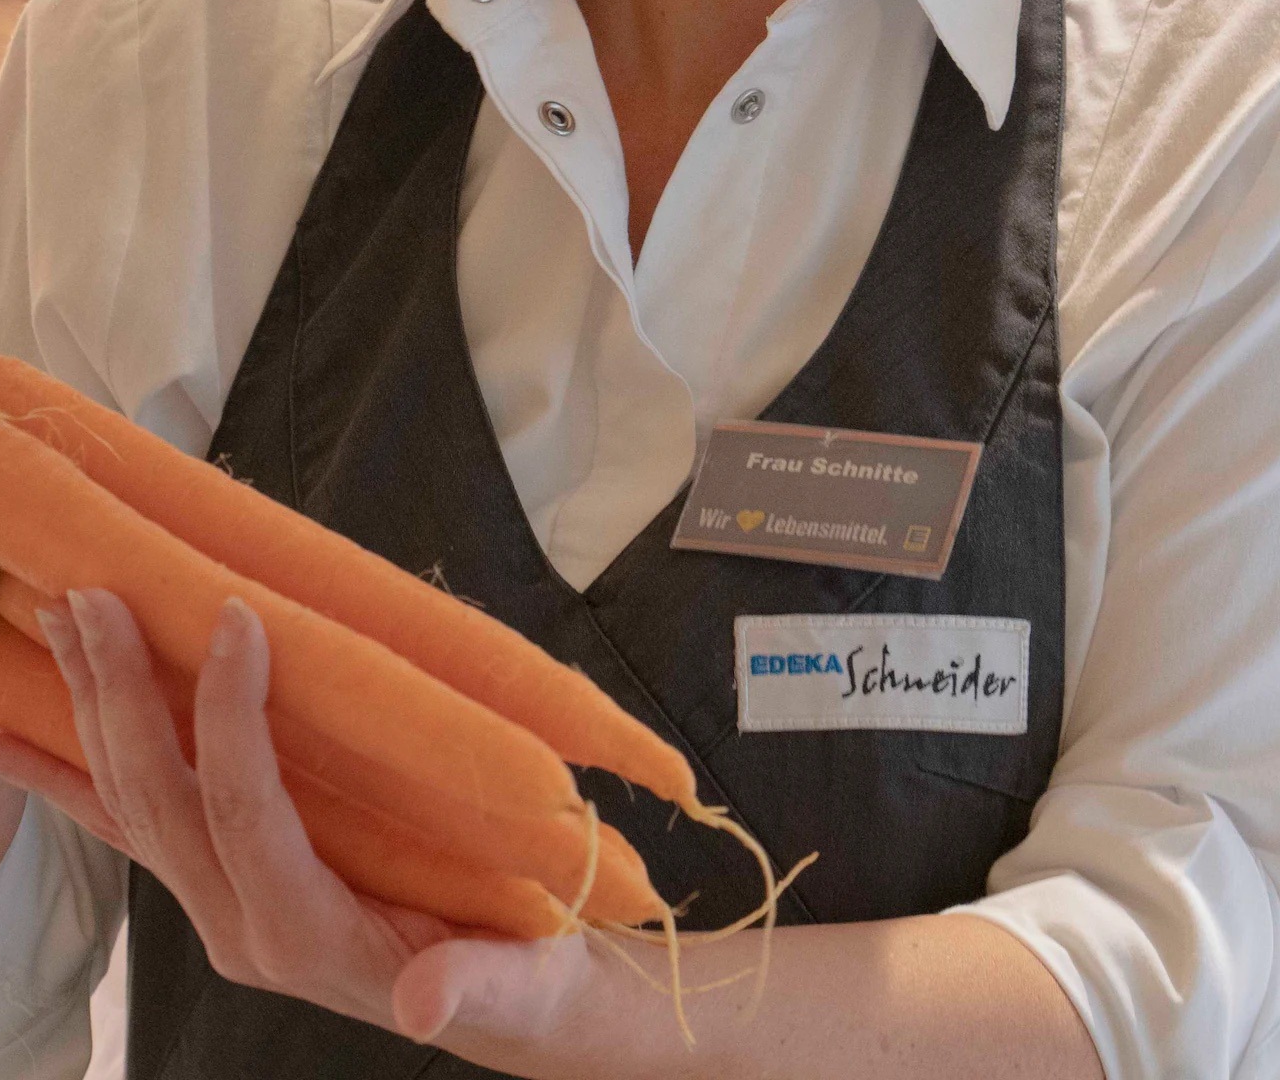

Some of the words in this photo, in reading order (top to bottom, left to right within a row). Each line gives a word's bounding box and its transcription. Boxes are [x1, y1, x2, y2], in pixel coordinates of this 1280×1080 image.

[746, 451, 803, 474] Frau
[810, 456, 919, 485] Schnitte
[699, 507, 732, 530] Wir
[765, 512, 888, 547] Lebensmittel.
[750, 653, 844, 676] EDEKA
[841, 642, 1017, 708] Schneider
